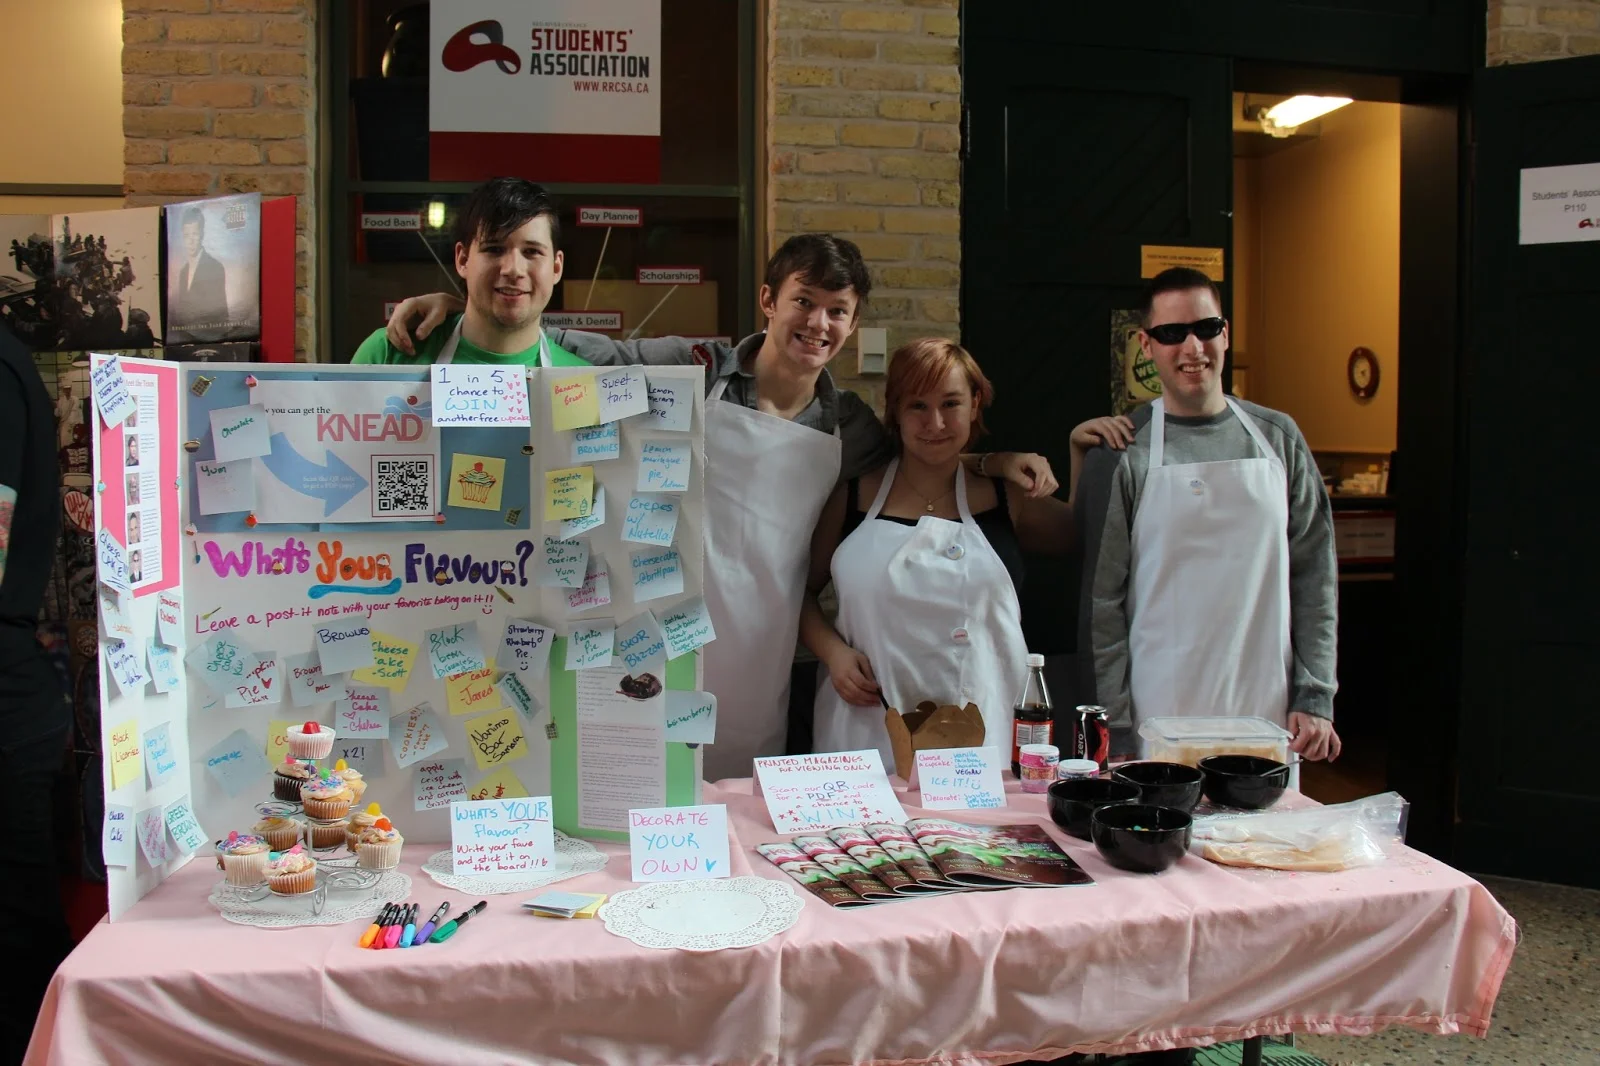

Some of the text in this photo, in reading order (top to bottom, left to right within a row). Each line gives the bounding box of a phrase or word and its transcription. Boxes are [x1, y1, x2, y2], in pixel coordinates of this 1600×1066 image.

[531, 28, 633, 53] STUDENTS'
[530, 53, 650, 78] ASSOCIATION
[573, 81, 650, 93] WWW.RRCSA.CA
[1564, 203, 1587, 212] P110
[364, 217, 417, 227] Food Bank
[581, 211, 638, 221] Day Planner
[640, 271, 699, 282] Scholarships
[542, 317, 617, 326] Health & Dental
[438, 367, 505, 383] 1 in 5
[449, 386, 504, 397] chance to
[271, 408, 286, 416] you
[303, 407, 315, 416] get
[316, 406, 331, 414] the
[445, 397, 497, 411] WIN
[316, 413, 424, 442] KNEAD
[629, 498, 674, 512] Crepes
[195, 614, 240, 634] Leave
[246, 614, 262, 625] a
[317, 605, 340, 617] note
[342, 601, 364, 614] with
[366, 602, 392, 619] your
[394, 597, 432, 610] favorite
[1077, 733, 1085, 756] zero
[420, 763, 444, 774] apple
[758, 758, 799, 768] PRINTED
[795, 764, 841, 773] VIEWING
[843, 763, 872, 772] ONLY
[768, 785, 799, 794] Scan
[823, 780, 850, 793] QR
[852, 782, 876, 790] code
[807, 792, 836, 801] PDF
[811, 799, 849, 808] chance
[456, 801, 549, 820] WHATS YOUR
[800, 808, 856, 823] WIN
[457, 838, 534, 853] Write your fave
[642, 832, 700, 851] YOUR
[457, 856, 473, 866] and
[478, 854, 502, 863] stick
[506, 852, 515, 860] it
[641, 856, 698, 876] OWN
[473, 864, 491, 872] the
